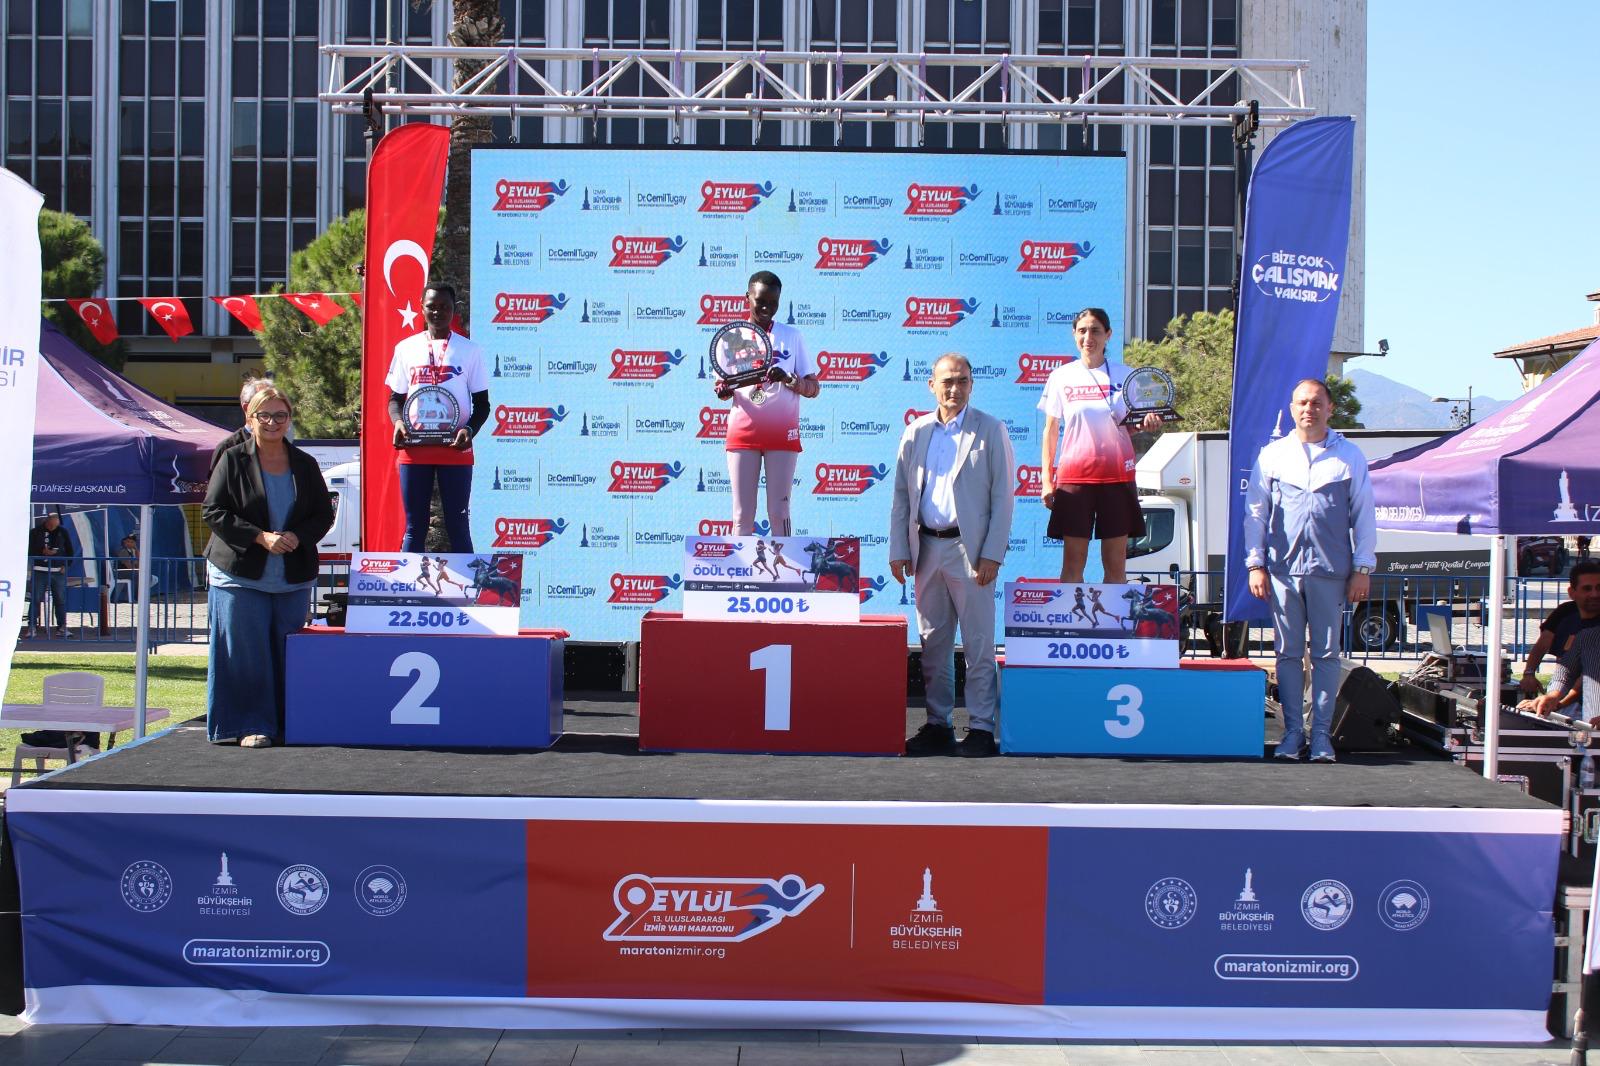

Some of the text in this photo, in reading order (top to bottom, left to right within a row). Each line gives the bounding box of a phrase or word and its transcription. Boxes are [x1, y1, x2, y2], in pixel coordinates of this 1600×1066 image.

[508, 185, 541, 197] EYLÜL
[714, 186, 747, 199] EYLÜL
[920, 189, 953, 201] EYLÜL
[624, 241, 657, 253] EYLÜL
[830, 244, 863, 256] EYLÜL
[1033, 246, 1066, 258] EYLÜL
[1271, 250, 1324, 268] BİZE ÇOK
[1252, 264, 1339, 291] ÇALIŞMAK
[1274, 286, 1318, 303] YAKIŞIR
[507, 298, 540, 311] EYLÜL
[713, 300, 746, 312] EYLÜL
[918, 302, 951, 314] EYLÜL
[624, 354, 657, 366] EYLÜL
[829, 356, 862, 368] EYLÜL
[507, 411, 540, 423] EYLÜL
[623, 466, 656, 478] EYLÜL
[828, 468, 861, 480] EYLÜL
[73, 484, 126, 494] BAŞKANLIĞI
[507, 522, 540, 534] EYLÜL
[693, 564, 753, 579] ÖDÜL ÇEKİ
[1388, 562, 1409, 572] Stage
[1410, 561, 1424, 569] and
[1440, 560, 1464, 572] Rental
[357, 580, 417, 594] ÖDÜL ÇEKİ
[622, 578, 655, 590] EYLÜL
[727, 596, 794, 613] 25.000
[388, 611, 454, 627] 22.500
[1013, 611, 1073, 626] ÖDÜL ÇEKİ
[1047, 642, 1114, 659] 20.000
[388, 651, 441, 725] 2
[749, 644, 792, 732] 1
[1104, 683, 1145, 739] 3
[212, 887, 238, 895] İZMİR
[197, 896, 253, 907] BÜYÜKŞEHİR
[650, 889, 732, 912] EYLÜL
[1234, 902, 1260, 910] İZMİR
[199, 907, 250, 916] BELEDİYESİ
[909, 912, 943, 923] İZMİR
[1218, 912, 1274, 922] BÜYÜKŞEHİR
[664, 915, 726, 923] ULUSLARARASI
[643, 923, 735, 933] İZMİR YARI MARATONU
[890, 924, 962, 938] BÜYÜKŞEHİR
[1220, 922, 1272, 931] BELEDİYESİ
[892, 938, 959, 950] BELEDİYESİ
[193, 944, 320, 963] maratonizmir.org
[620, 945, 726, 958] maratonizmir.org
[1224, 958, 1349, 977] maratonizmir.org
